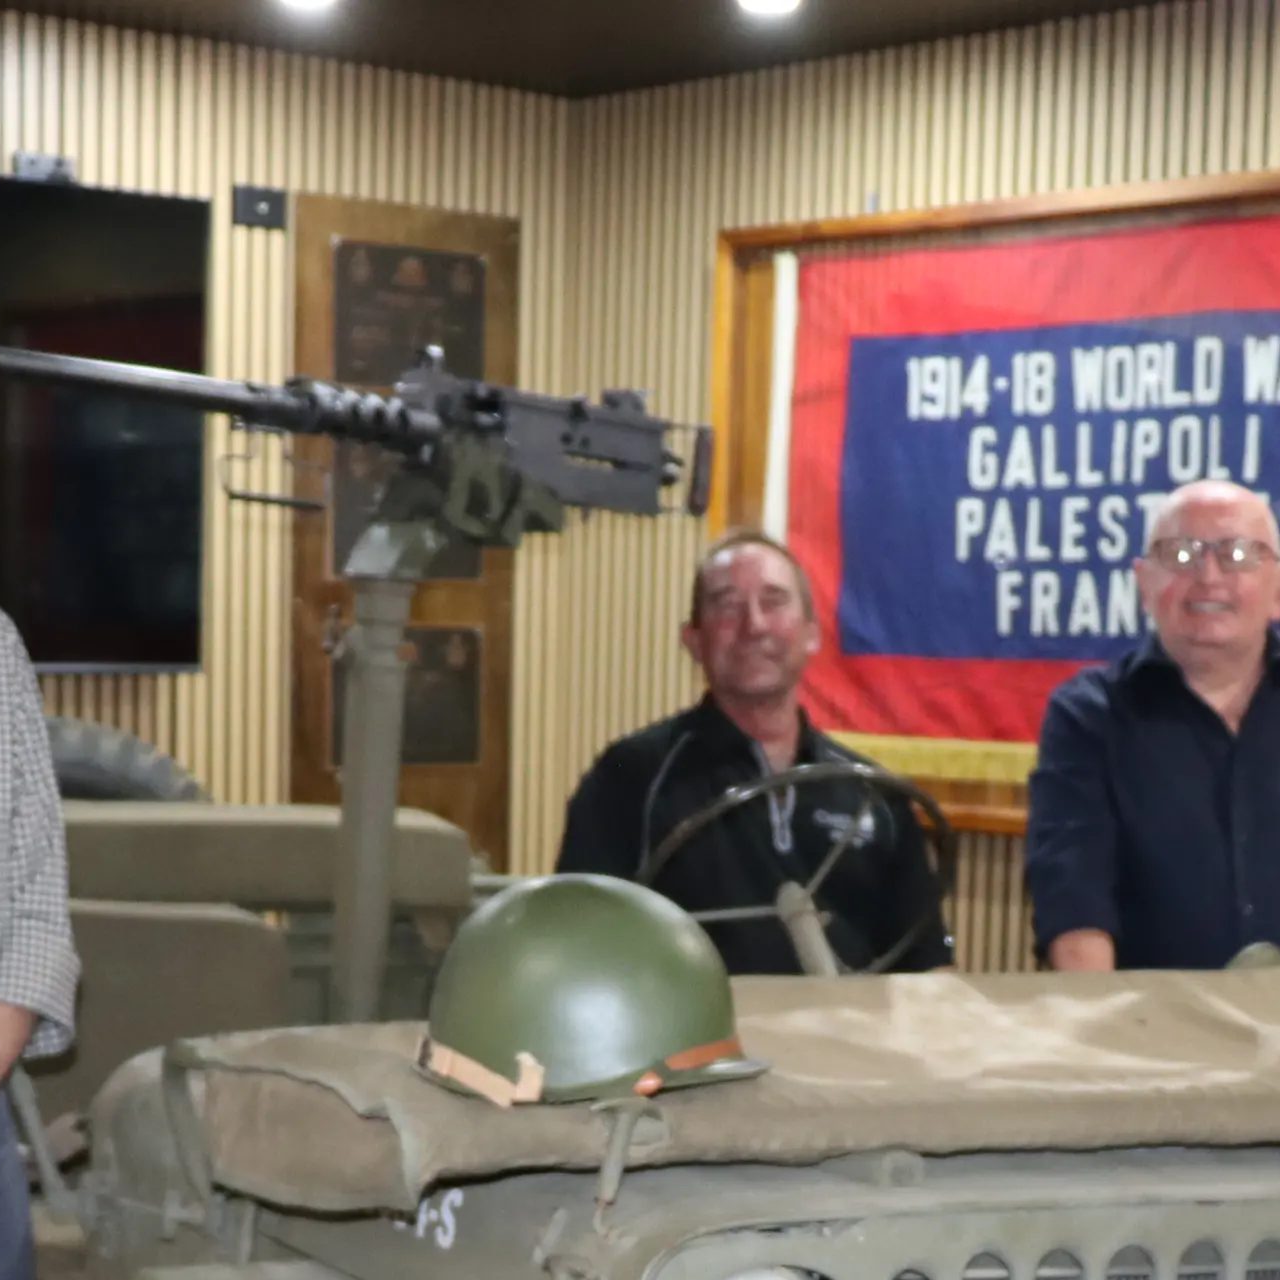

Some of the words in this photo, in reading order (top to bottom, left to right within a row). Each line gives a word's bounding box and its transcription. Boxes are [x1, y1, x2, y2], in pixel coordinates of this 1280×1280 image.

[1071, 337, 1224, 413] WORLD
[967, 415, 1261, 490] GALLIPOLI
[954, 492, 1278, 564] PALEST
[996, 569, 1157, 638] FRAN
